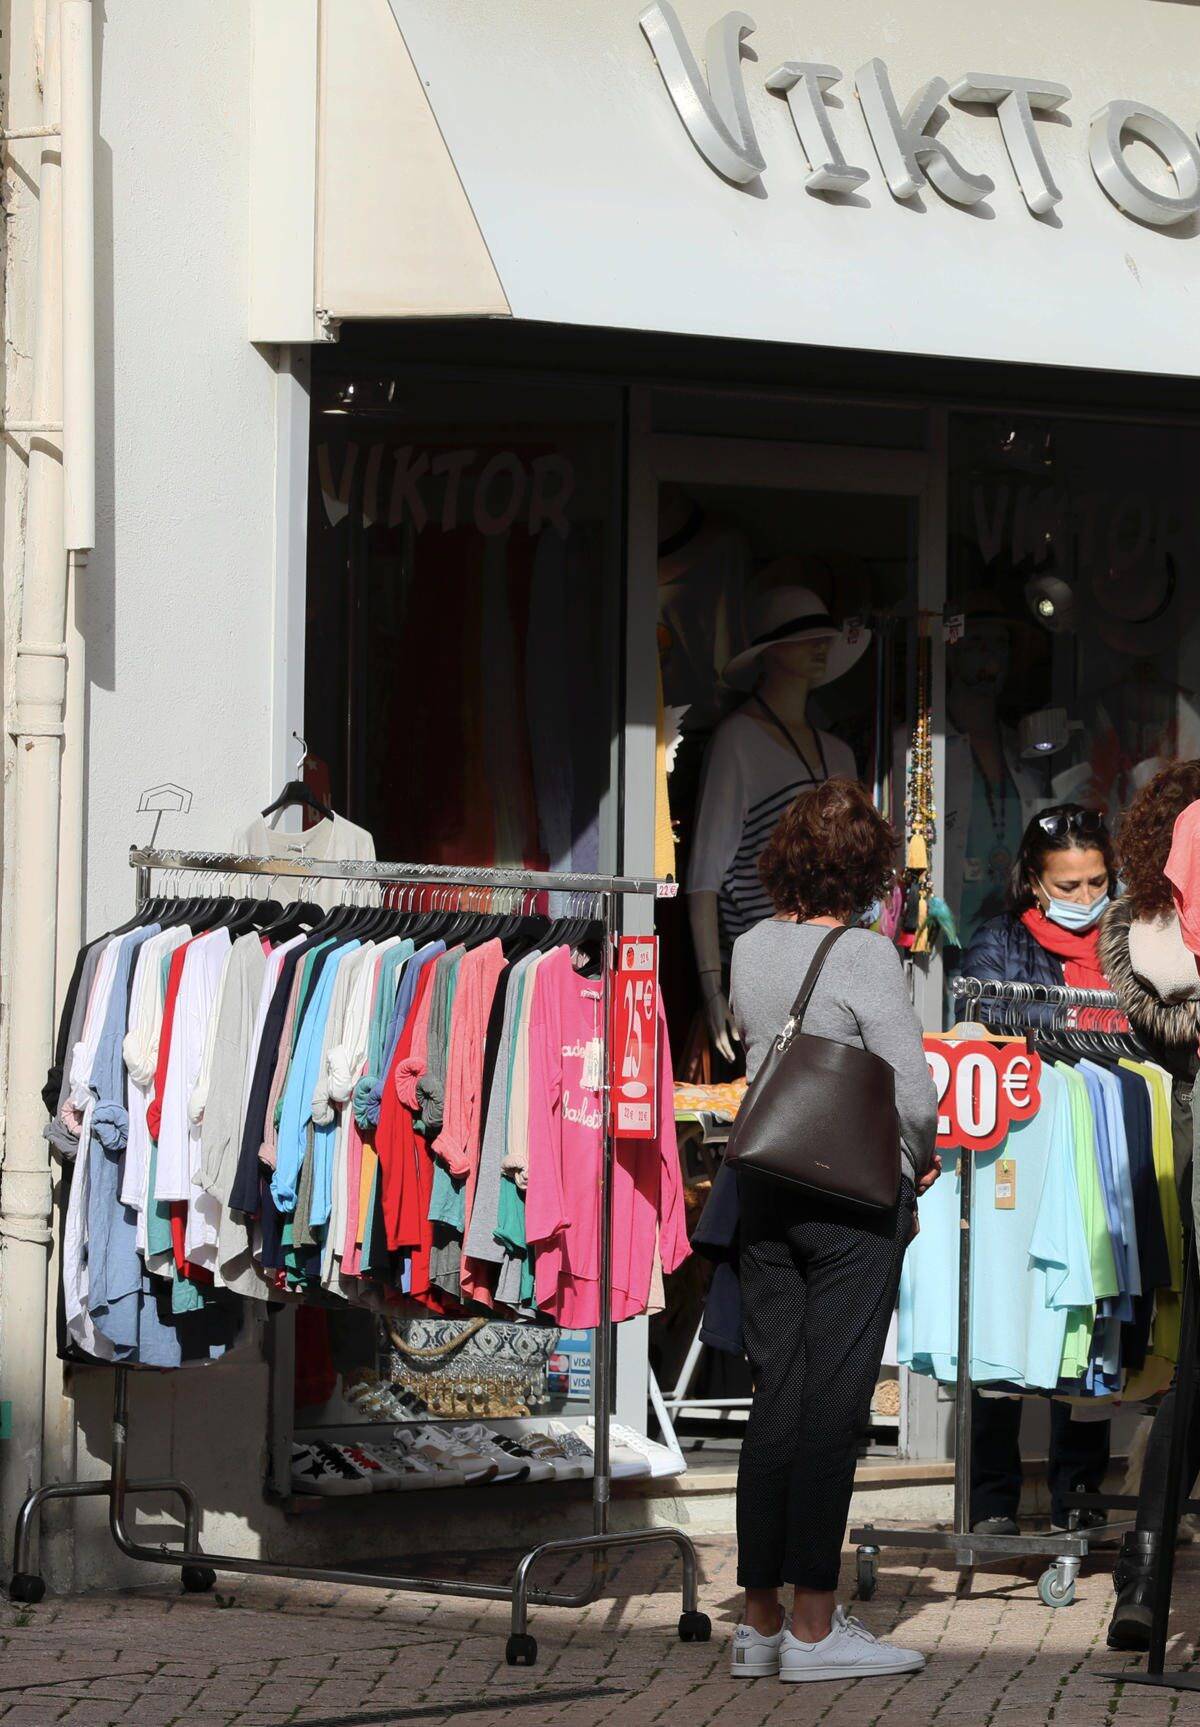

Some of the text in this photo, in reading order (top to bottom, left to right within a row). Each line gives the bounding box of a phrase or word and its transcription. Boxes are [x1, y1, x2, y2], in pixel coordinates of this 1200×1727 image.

[316, 440, 576, 540] VIKTOR
[659, 885, 677, 896] 22€
[622, 979, 654, 1079] 25€
[573, 1357, 591, 1367] VISA
[573, 1378, 591, 1388] VISA
